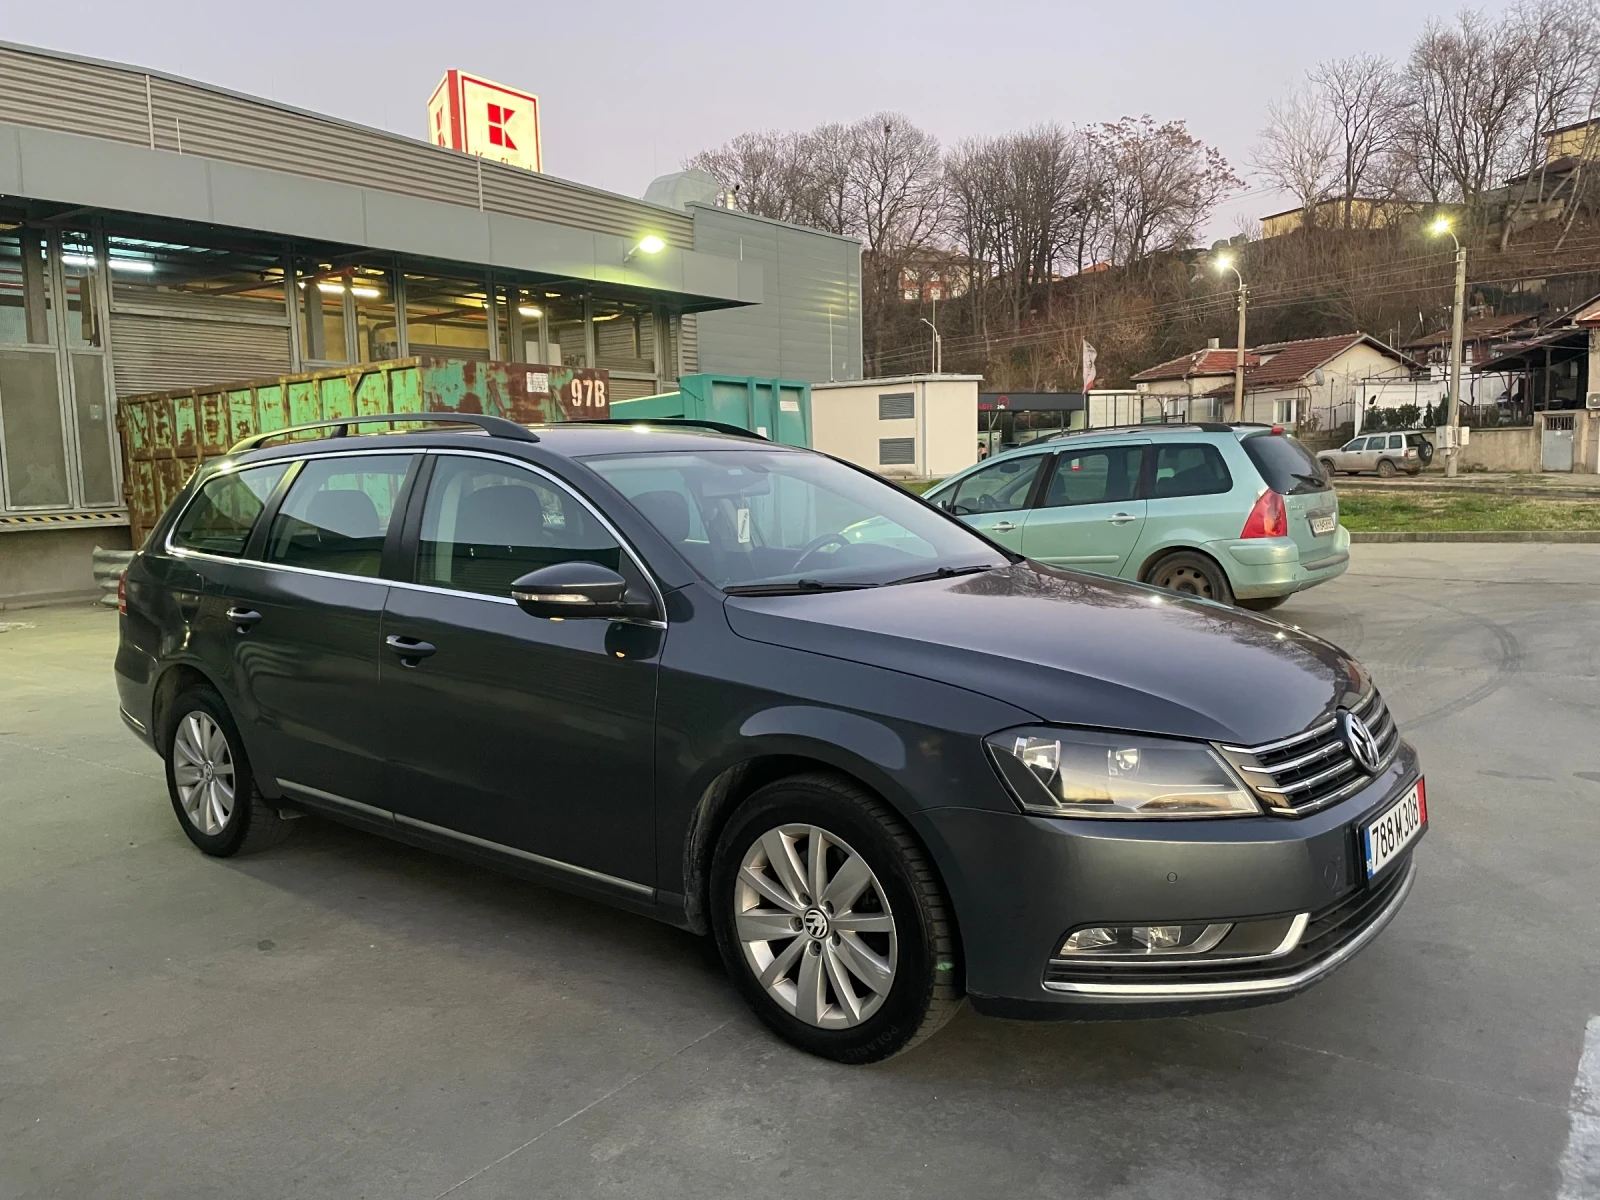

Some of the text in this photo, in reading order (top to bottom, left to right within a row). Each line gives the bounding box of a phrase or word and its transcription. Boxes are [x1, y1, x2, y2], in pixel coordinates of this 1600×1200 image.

[487, 102, 518, 151] K
[571, 378, 606, 408] 97B
[1372, 793, 1419, 866] 788 M 308
